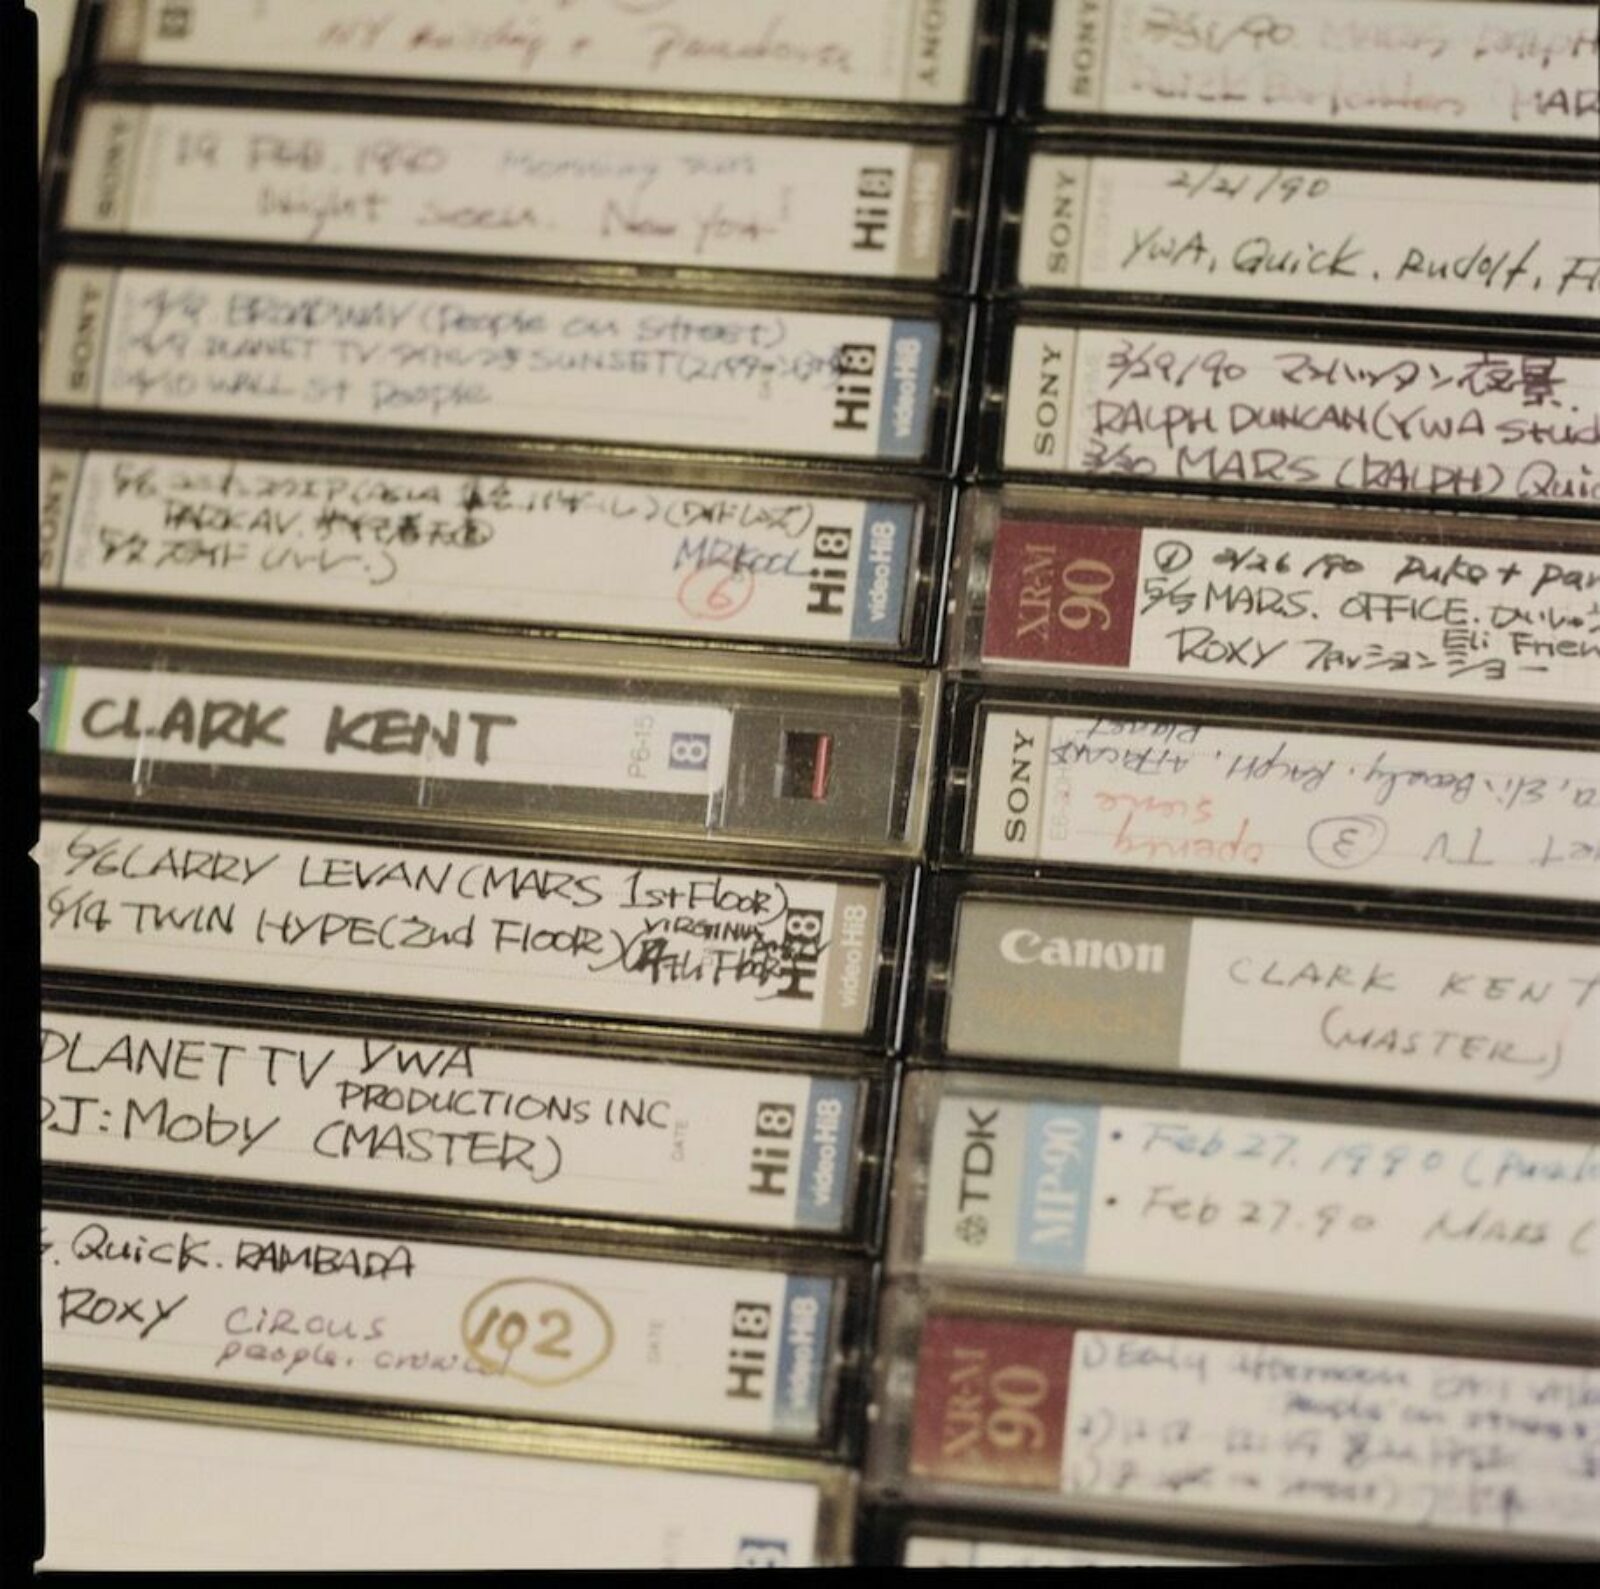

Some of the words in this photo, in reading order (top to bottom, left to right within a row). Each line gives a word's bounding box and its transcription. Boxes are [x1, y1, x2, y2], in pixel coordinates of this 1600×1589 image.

[1048, 171, 1077, 276] SONY
[833, 342, 877, 432] Hi8
[1034, 343, 1063, 457] SONY
[1174, 446, 1323, 484] MARS
[806, 525, 853, 616] Hi8
[870, 519, 897, 564] Hi8
[869, 565, 893, 623] video
[1014, 542, 1057, 641] XR-M
[1057, 556, 1117, 634] 90
[1165, 625, 1291, 669] ROXY
[80, 696, 291, 751] CLARK
[322, 703, 519, 766] KENT
[1005, 730, 1035, 845] SONY
[120, 843, 281, 887] LARRY
[298, 853, 454, 894] LEVAN
[1421, 824, 1495, 867] TV
[120, 899, 238, 936] TWIN
[842, 901, 869, 948] Hi8
[999, 927, 1167, 974] Canon
[840, 951, 864, 1009] video
[1227, 953, 1398, 995] CLARK
[1439, 970, 1600, 1009] KENT
[257, 1045, 336, 1090] TV
[334, 1079, 590, 1127] PRODUCTIONS
[602, 1095, 672, 1132] INC
[815, 1097, 843, 1144] Hi8
[120, 1096, 281, 1158] Moby
[311, 1119, 565, 1184] (MASTER)
[748, 1101, 796, 1196] Hi8
[958, 1107, 1000, 1212] TDK
[814, 1144, 837, 1206] video
[1029, 1115, 1085, 1248] MP-90
[1139, 1182, 1219, 1224] Feb
[234, 1238, 417, 1281] RAMBADA
[57, 1285, 190, 1340] ROXY
[724, 1299, 773, 1400] Hi8
[986, 1363, 1050, 1454] 90
